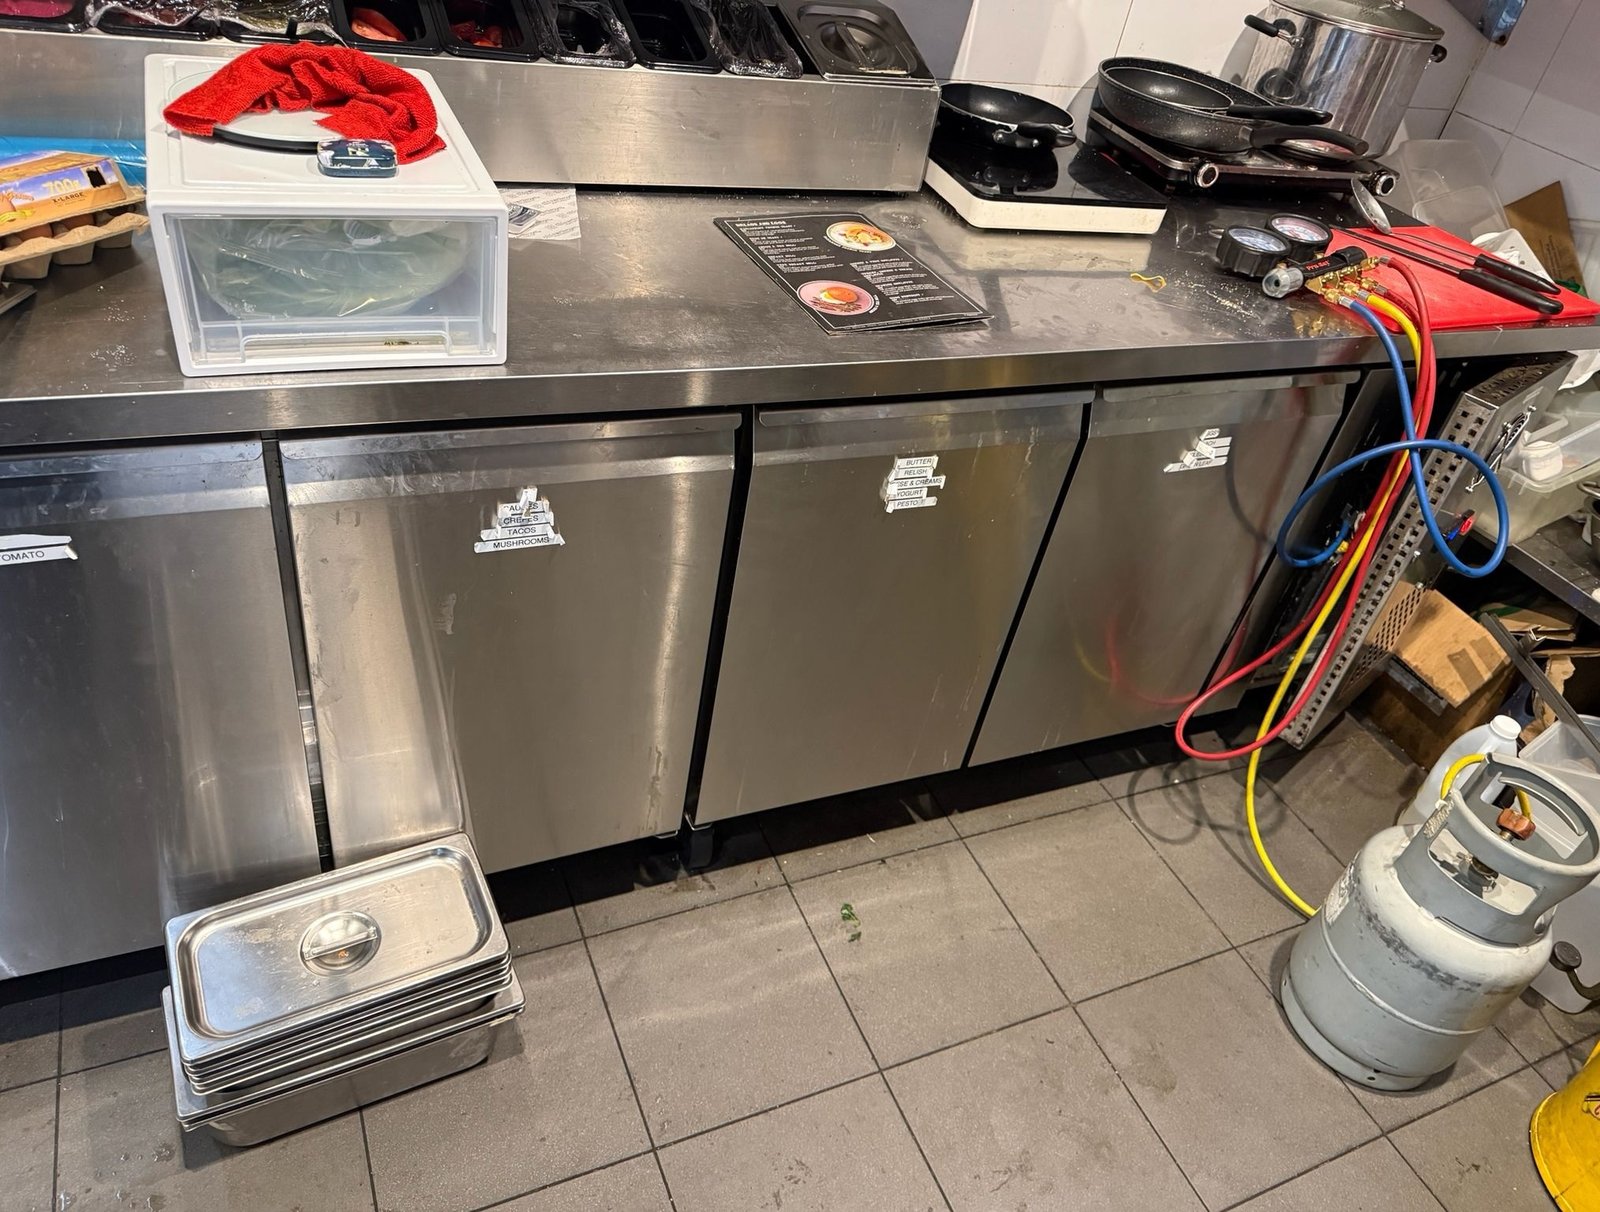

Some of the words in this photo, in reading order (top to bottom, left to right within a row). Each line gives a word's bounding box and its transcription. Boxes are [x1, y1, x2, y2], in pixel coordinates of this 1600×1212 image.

[906, 458, 932, 466] BUTTER
[915, 478, 943, 486] CREAMS
[507, 527, 537, 535] TACOS
[493, 536, 550, 549] MUSHROOMS
[0, 550, 45, 561] OMATO
